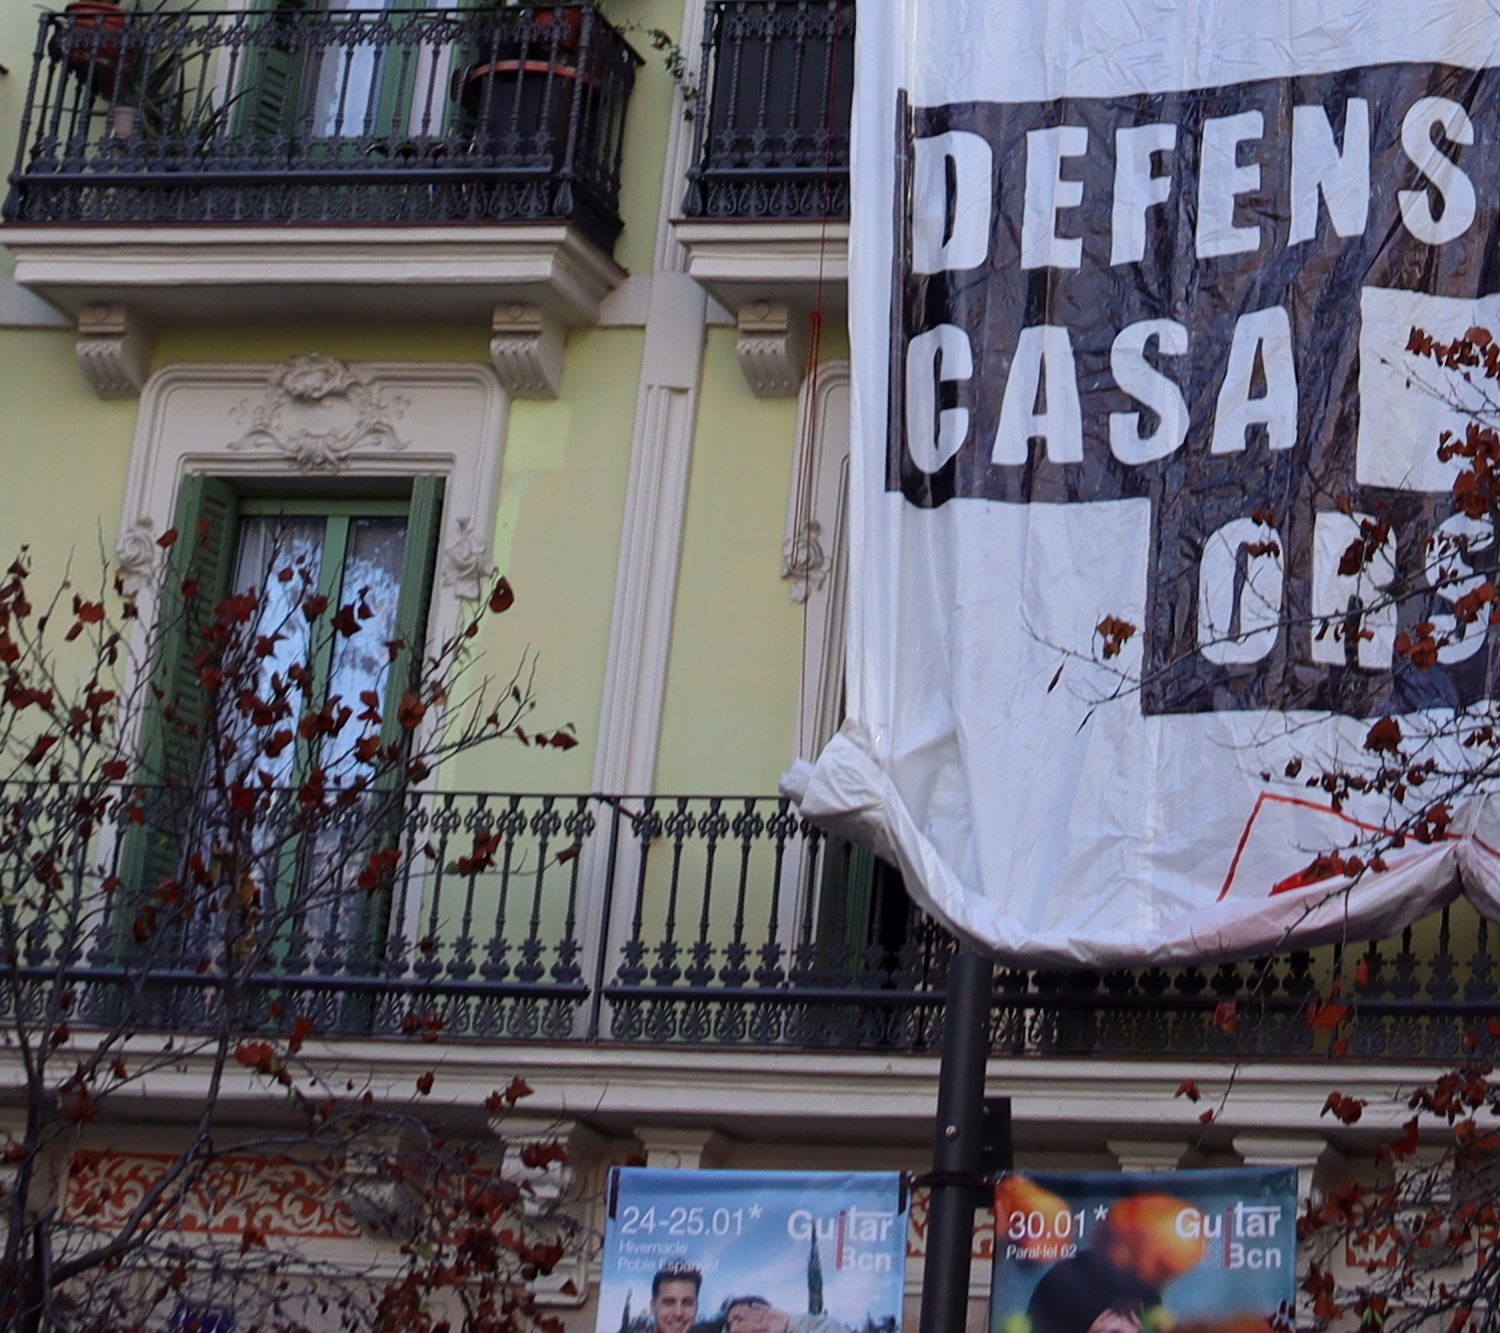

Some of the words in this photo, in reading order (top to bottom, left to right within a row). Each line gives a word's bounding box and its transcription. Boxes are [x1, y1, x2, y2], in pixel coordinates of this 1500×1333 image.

[905, 306, 1298, 474] CASA
[787, 1205, 894, 1242] Guitar
[1175, 1201, 1281, 1240] Guitar
[618, 1240, 688, 1254] Hivernacle
[842, 1246, 892, 1271] Bcn
[1060, 1245, 1077, 1259] 62
[1229, 1243, 1281, 1269] Bcn
[617, 1258, 656, 1271] Poble
